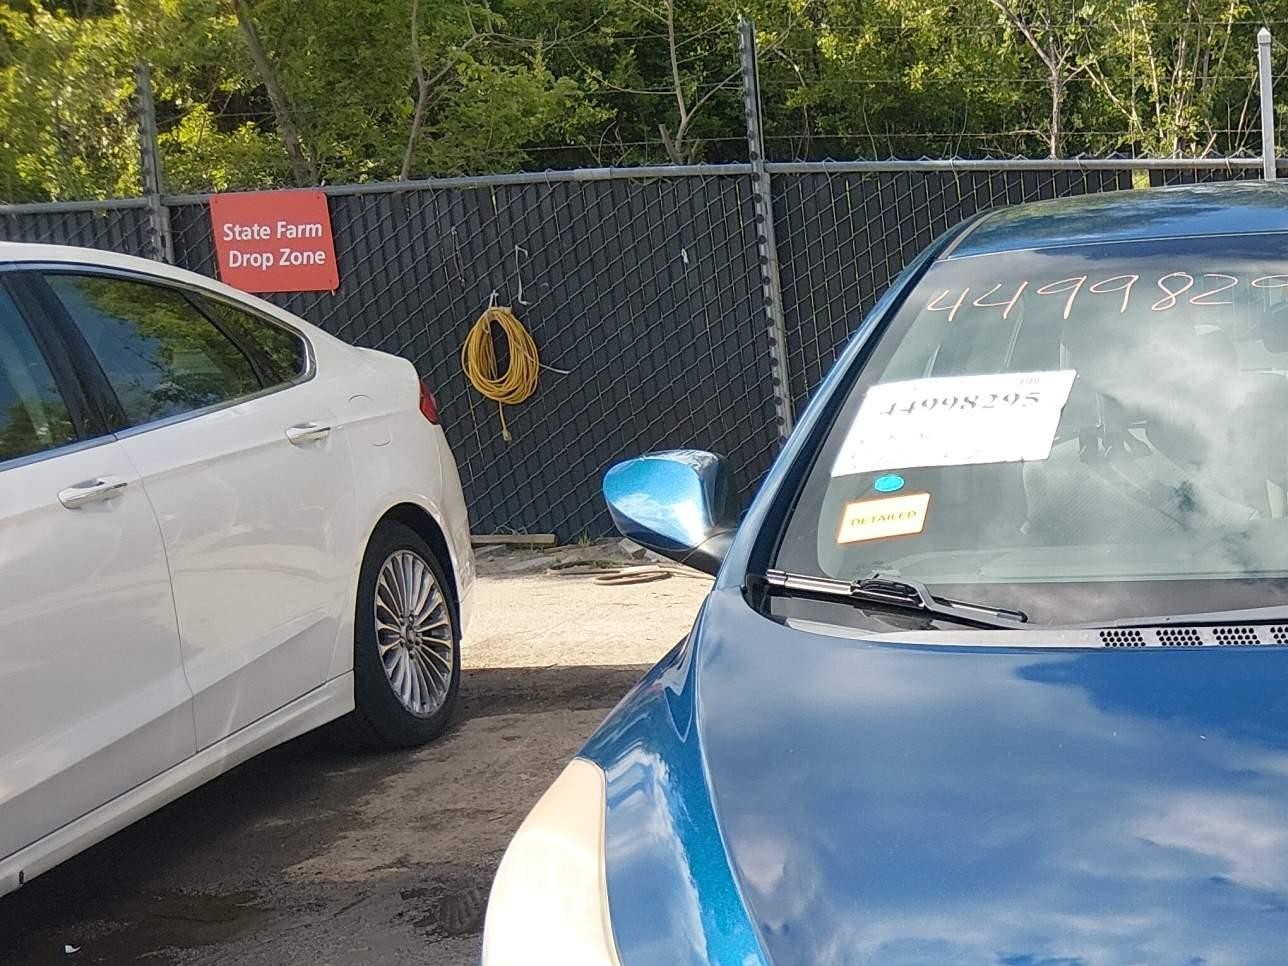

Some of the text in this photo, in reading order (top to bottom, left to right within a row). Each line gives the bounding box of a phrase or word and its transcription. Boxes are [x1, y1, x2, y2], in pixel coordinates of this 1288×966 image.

[223, 221, 322, 241] State Farm
[228, 248, 326, 271] Drop Zone
[850, 509, 917, 526] DETAILED
